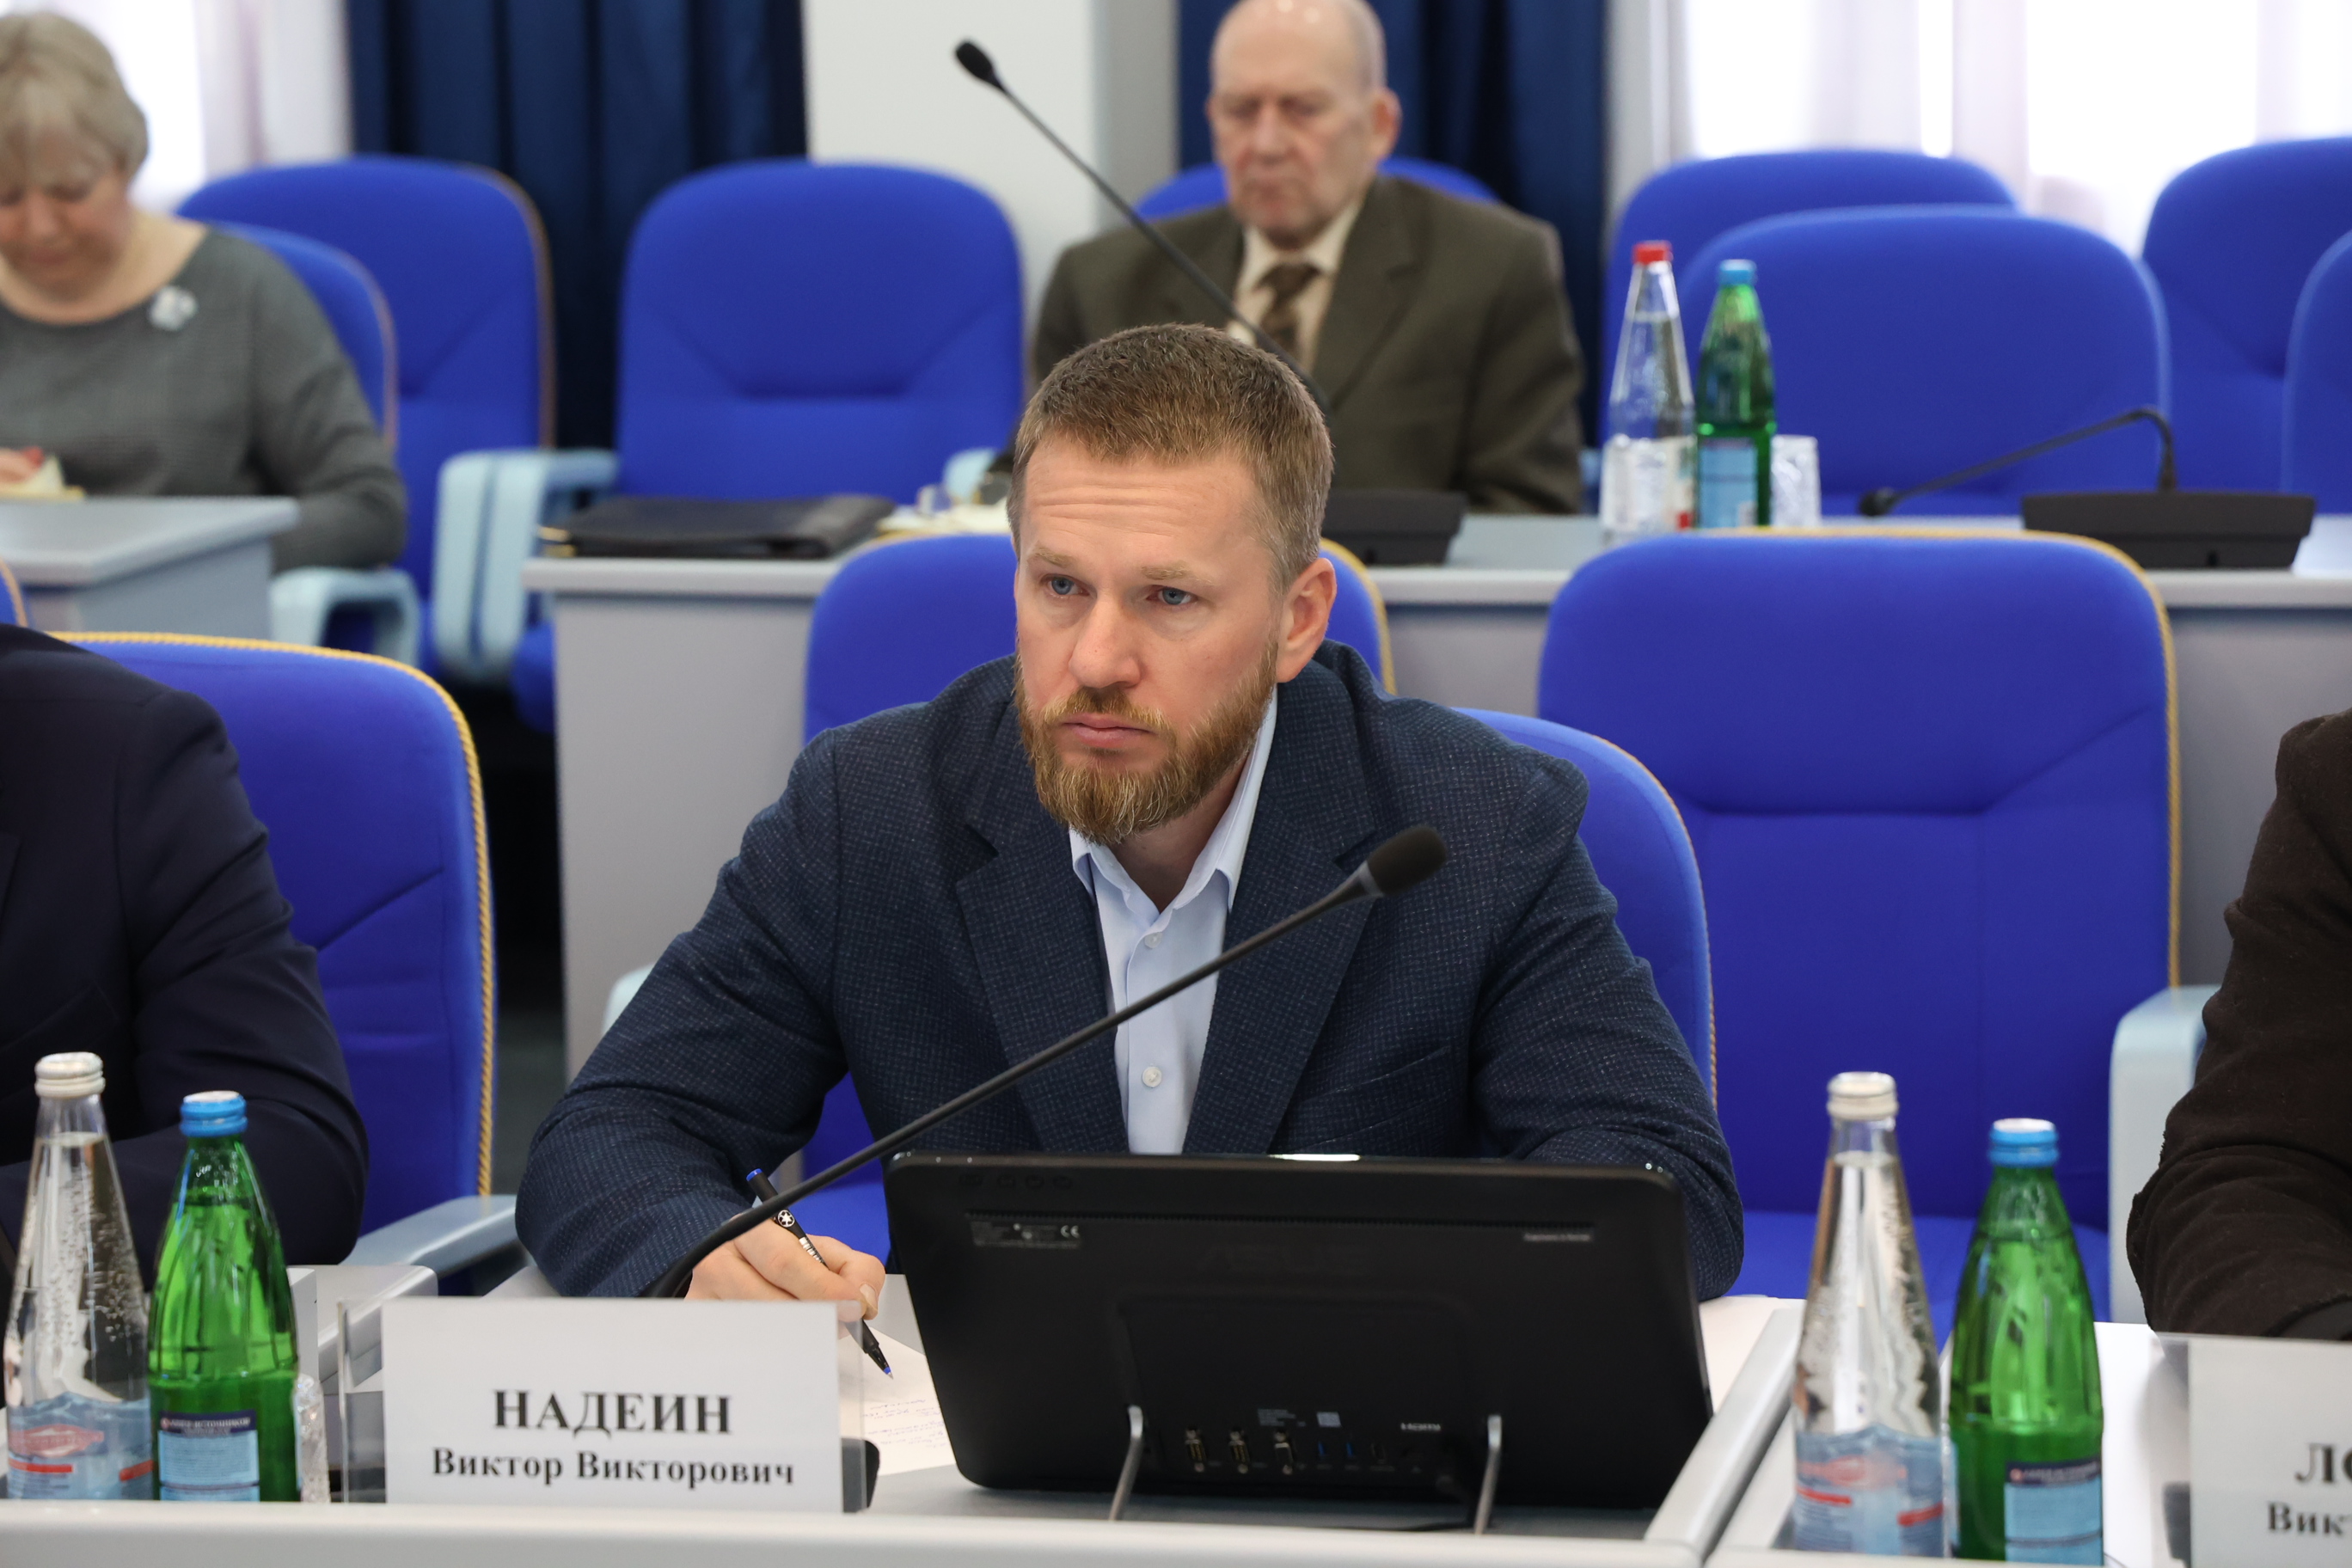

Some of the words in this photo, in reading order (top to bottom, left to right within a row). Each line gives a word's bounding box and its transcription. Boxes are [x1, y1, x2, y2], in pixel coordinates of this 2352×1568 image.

[493, 1389, 732, 1438] НАДЕИН
[432, 1447, 564, 1486] Виктор
[577, 1450, 794, 1491] Викторович
